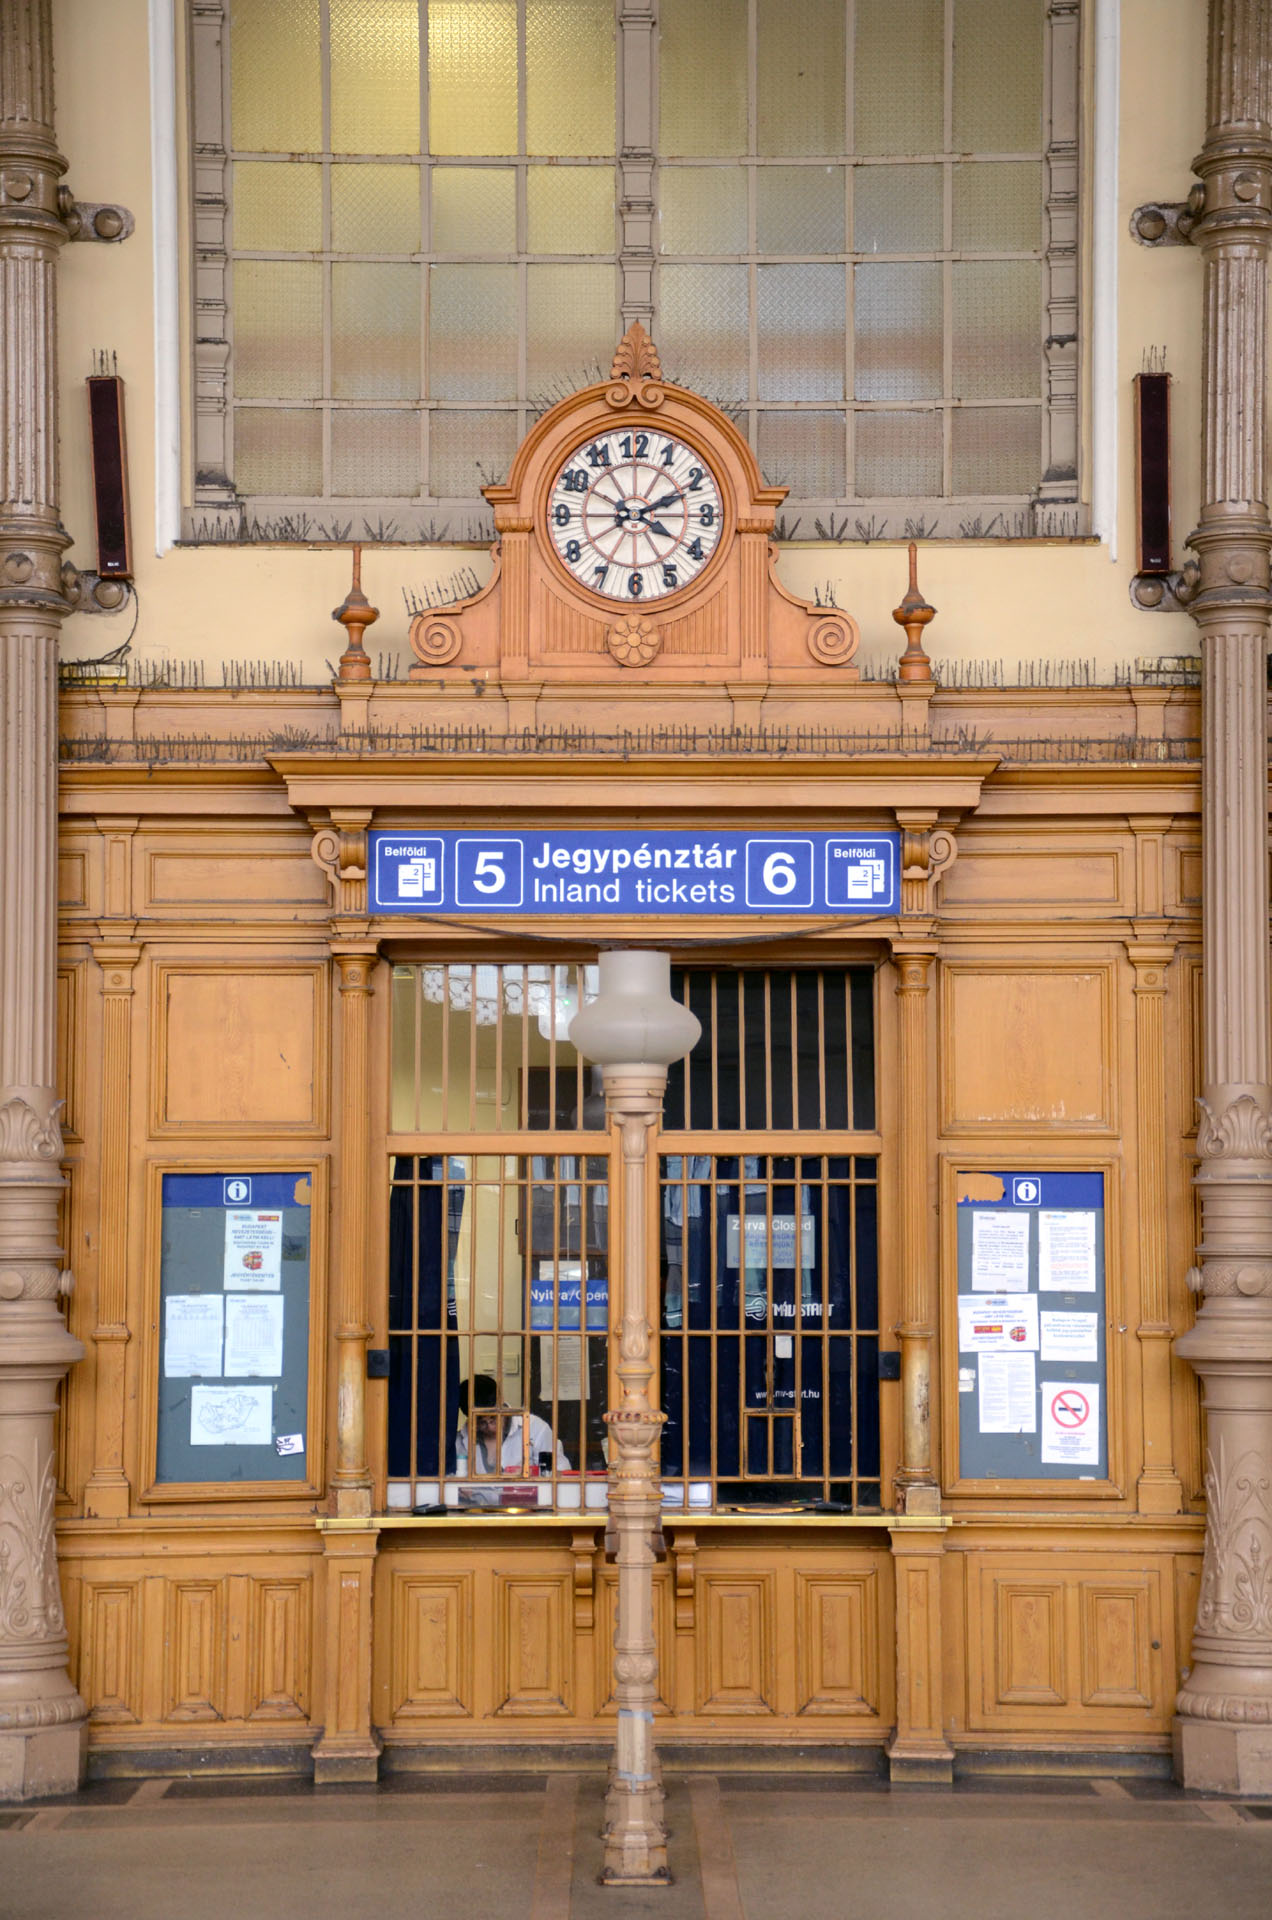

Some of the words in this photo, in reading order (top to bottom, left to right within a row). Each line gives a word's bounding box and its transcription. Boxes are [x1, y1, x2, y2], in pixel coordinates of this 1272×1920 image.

[586, 443, 611, 467] 11
[619, 434, 649, 458] 12
[661, 442, 674, 466] 1
[561, 469, 588, 493] 10
[688, 467, 703, 491] 2
[555, 504, 570, 527] 9
[700, 504, 714, 527] 3
[566, 539, 581, 562] 8
[687, 537, 703, 560] 4
[594, 566, 608, 589] 7
[628, 572, 643, 596] 6
[663, 564, 677, 588] 5
[384, 846, 427, 857] Belföldi
[532, 842, 737, 874] Jegypénztár
[834, 848, 876, 858] Belföldi
[472, 852, 506, 894] 5
[763, 851, 797, 895] 6
[534, 878, 620, 903] Inland
[635, 878, 736, 903] tickets
[772, 1219, 812, 1231] Closd
[530, 1289, 609, 1303] Nyita/Open
